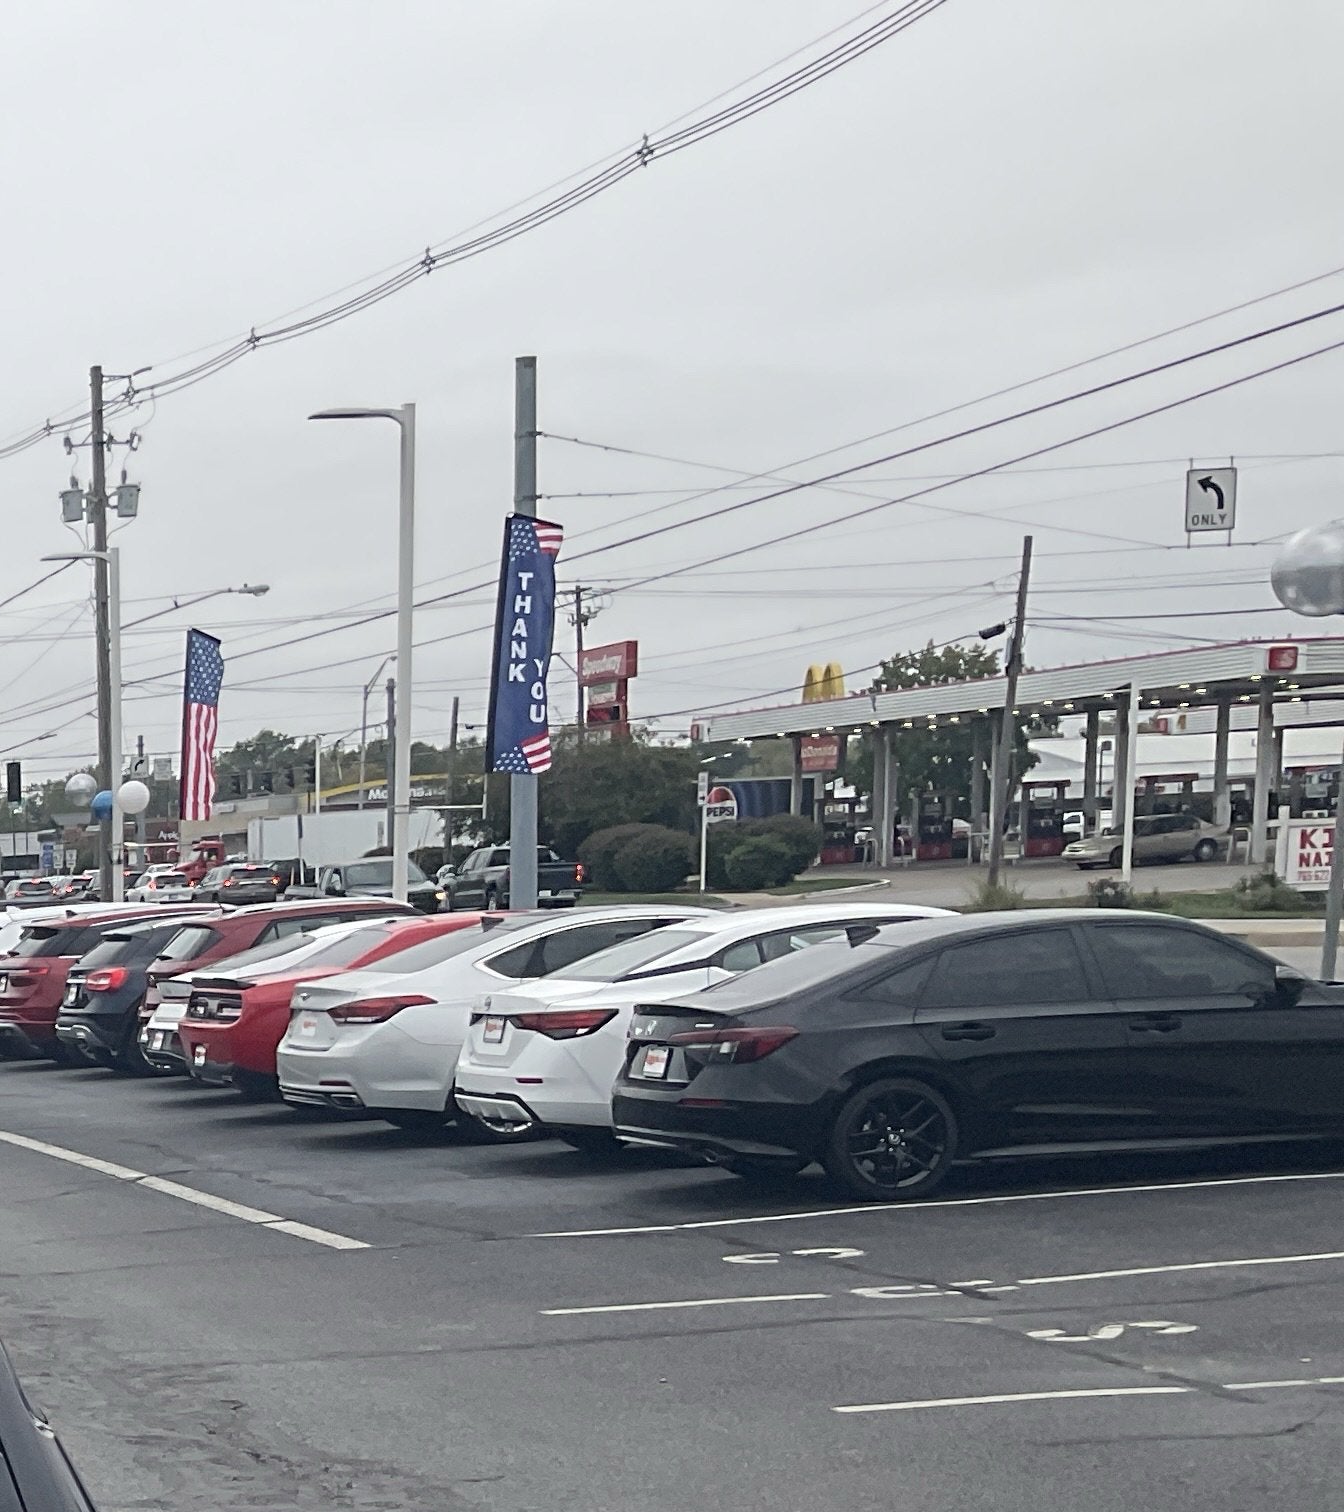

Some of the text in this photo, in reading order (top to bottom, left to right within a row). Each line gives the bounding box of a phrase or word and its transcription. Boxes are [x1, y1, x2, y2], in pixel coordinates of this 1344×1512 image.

[1191, 513, 1227, 526] ONLY
[508, 572, 534, 682] THANK
[529, 658, 546, 723] YOU
[706, 807, 735, 817] PEPSI
